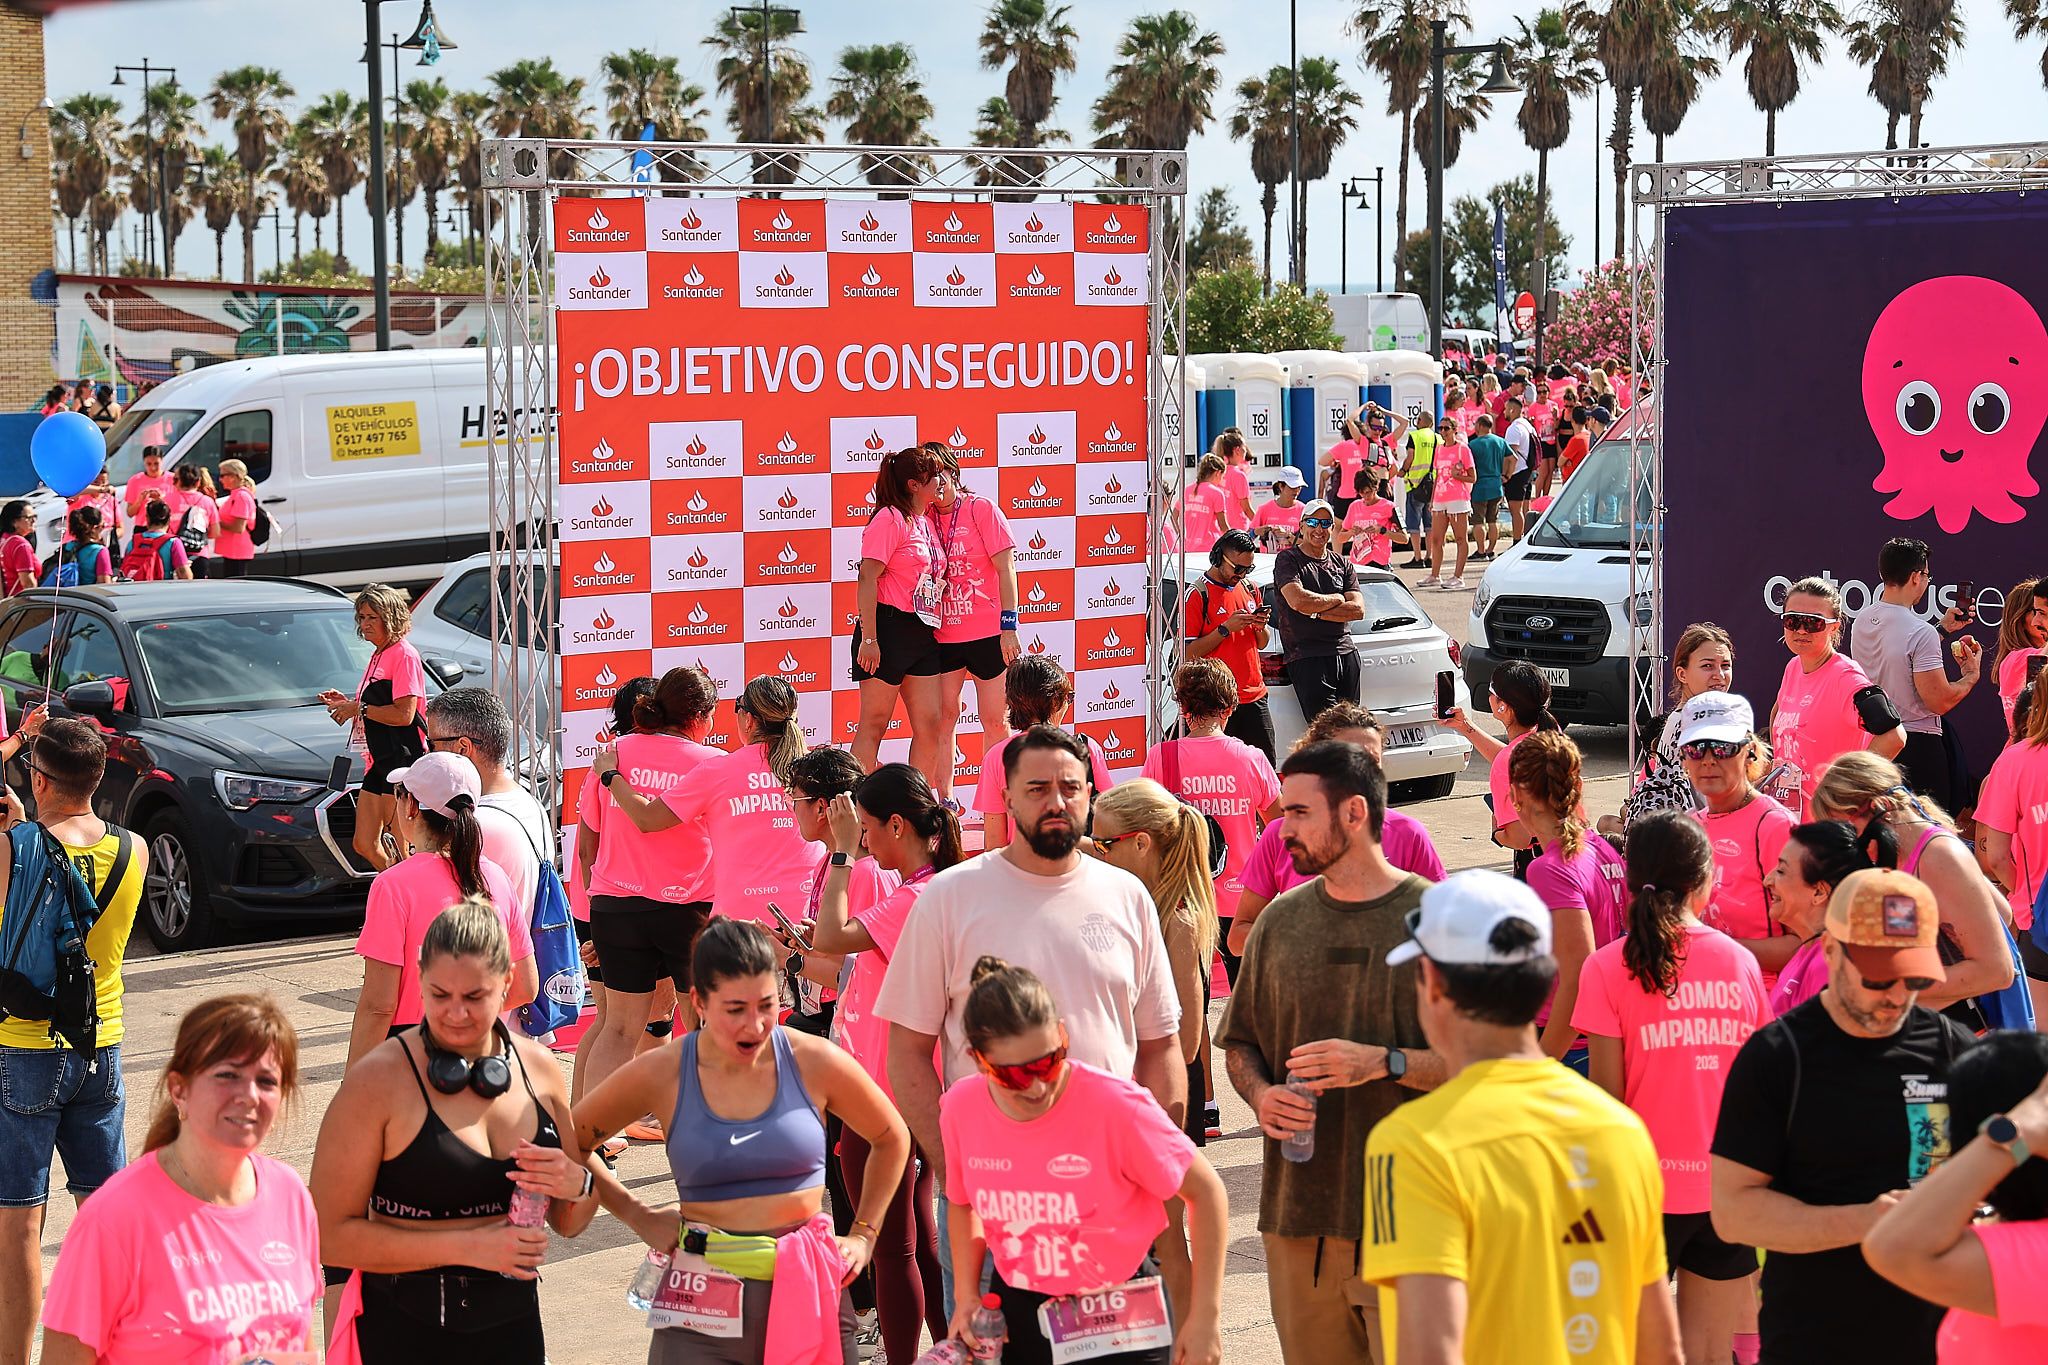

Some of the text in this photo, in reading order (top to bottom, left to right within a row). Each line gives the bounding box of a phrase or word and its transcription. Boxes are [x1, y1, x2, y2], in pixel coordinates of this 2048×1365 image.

[567, 229, 630, 243] Santander
[661, 229, 722, 242] Santander
[753, 229, 812, 243] Santander
[841, 230, 898, 243] Santander
[926, 230, 981, 244] Santander
[1008, 231, 1060, 244] Santander
[1086, 231, 1137, 245] Santander
[568, 286, 631, 300] Santander
[663, 285, 724, 299] Santander
[755, 286, 814, 298] Santander
[843, 285, 900, 298] Santander
[929, 285, 983, 298] Santander
[1009, 284, 1062, 297] Santander
[1088, 284, 1138, 297] Santander
[574, 339, 1134, 412] ¡OBJETIVO CONSEGUIDO!
[333, 406, 386, 419] ALQUILER
[1165, 413, 1179, 425] TO
[1252, 413, 1268, 425] TOI
[1331, 408, 1346, 420] TOI
[335, 417, 413, 433] DE VEHÍCULOS
[1167, 425, 1180, 437] TO
[1252, 425, 1268, 437] TOI
[344, 430, 408, 445] 917 497 765
[949, 446, 985, 458] tander
[1012, 443, 1063, 457] Santander
[1088, 441, 1137, 454] Santander
[572, 458, 634, 473] Santander
[666, 455, 727, 469] Santander
[757, 452, 816, 466] Santander
[1012, 496, 1063, 509] Santander
[1088, 493, 1138, 506] Santander
[667, 511, 728, 525] Santander
[758, 508, 817, 521] Santander
[570, 516, 634, 530] Santander
[1013, 549, 1063, 562] Santander
[1087, 544, 1137, 558] Santander
[667, 566, 728, 581] Santander
[758, 563, 817, 577] Santander
[573, 573, 636, 588] Santander
[943, 600, 974, 615] UJER
[1017, 601, 1062, 614] antander
[1087, 595, 1136, 609] Santander
[667, 622, 728, 638] Santander
[759, 616, 817, 631] Santander
[573, 628, 636, 644] Santander
[1087, 646, 1136, 660] Santander
[1362, 655, 1416, 667] DACIA
[1086, 698, 1136, 713] Santander
[1104, 748, 1136, 761] tander
[1181, 774, 1237, 795] SOMOS
[772, 817, 794, 828] 2026
[744, 886, 779, 896] OYSHO
[1666, 981, 1743, 1011] SOMOS
[1695, 1055, 1719, 1070] 2026
[968, 1156, 1012, 1171] OYSHO
[1658, 1159, 1707, 1172] OYSHO
[376, 1195, 432, 1218] PUMA
[669, 1270, 708, 1293] 016
[1081, 1290, 1127, 1314] 016
[692, 1320, 727, 1331] Santander
